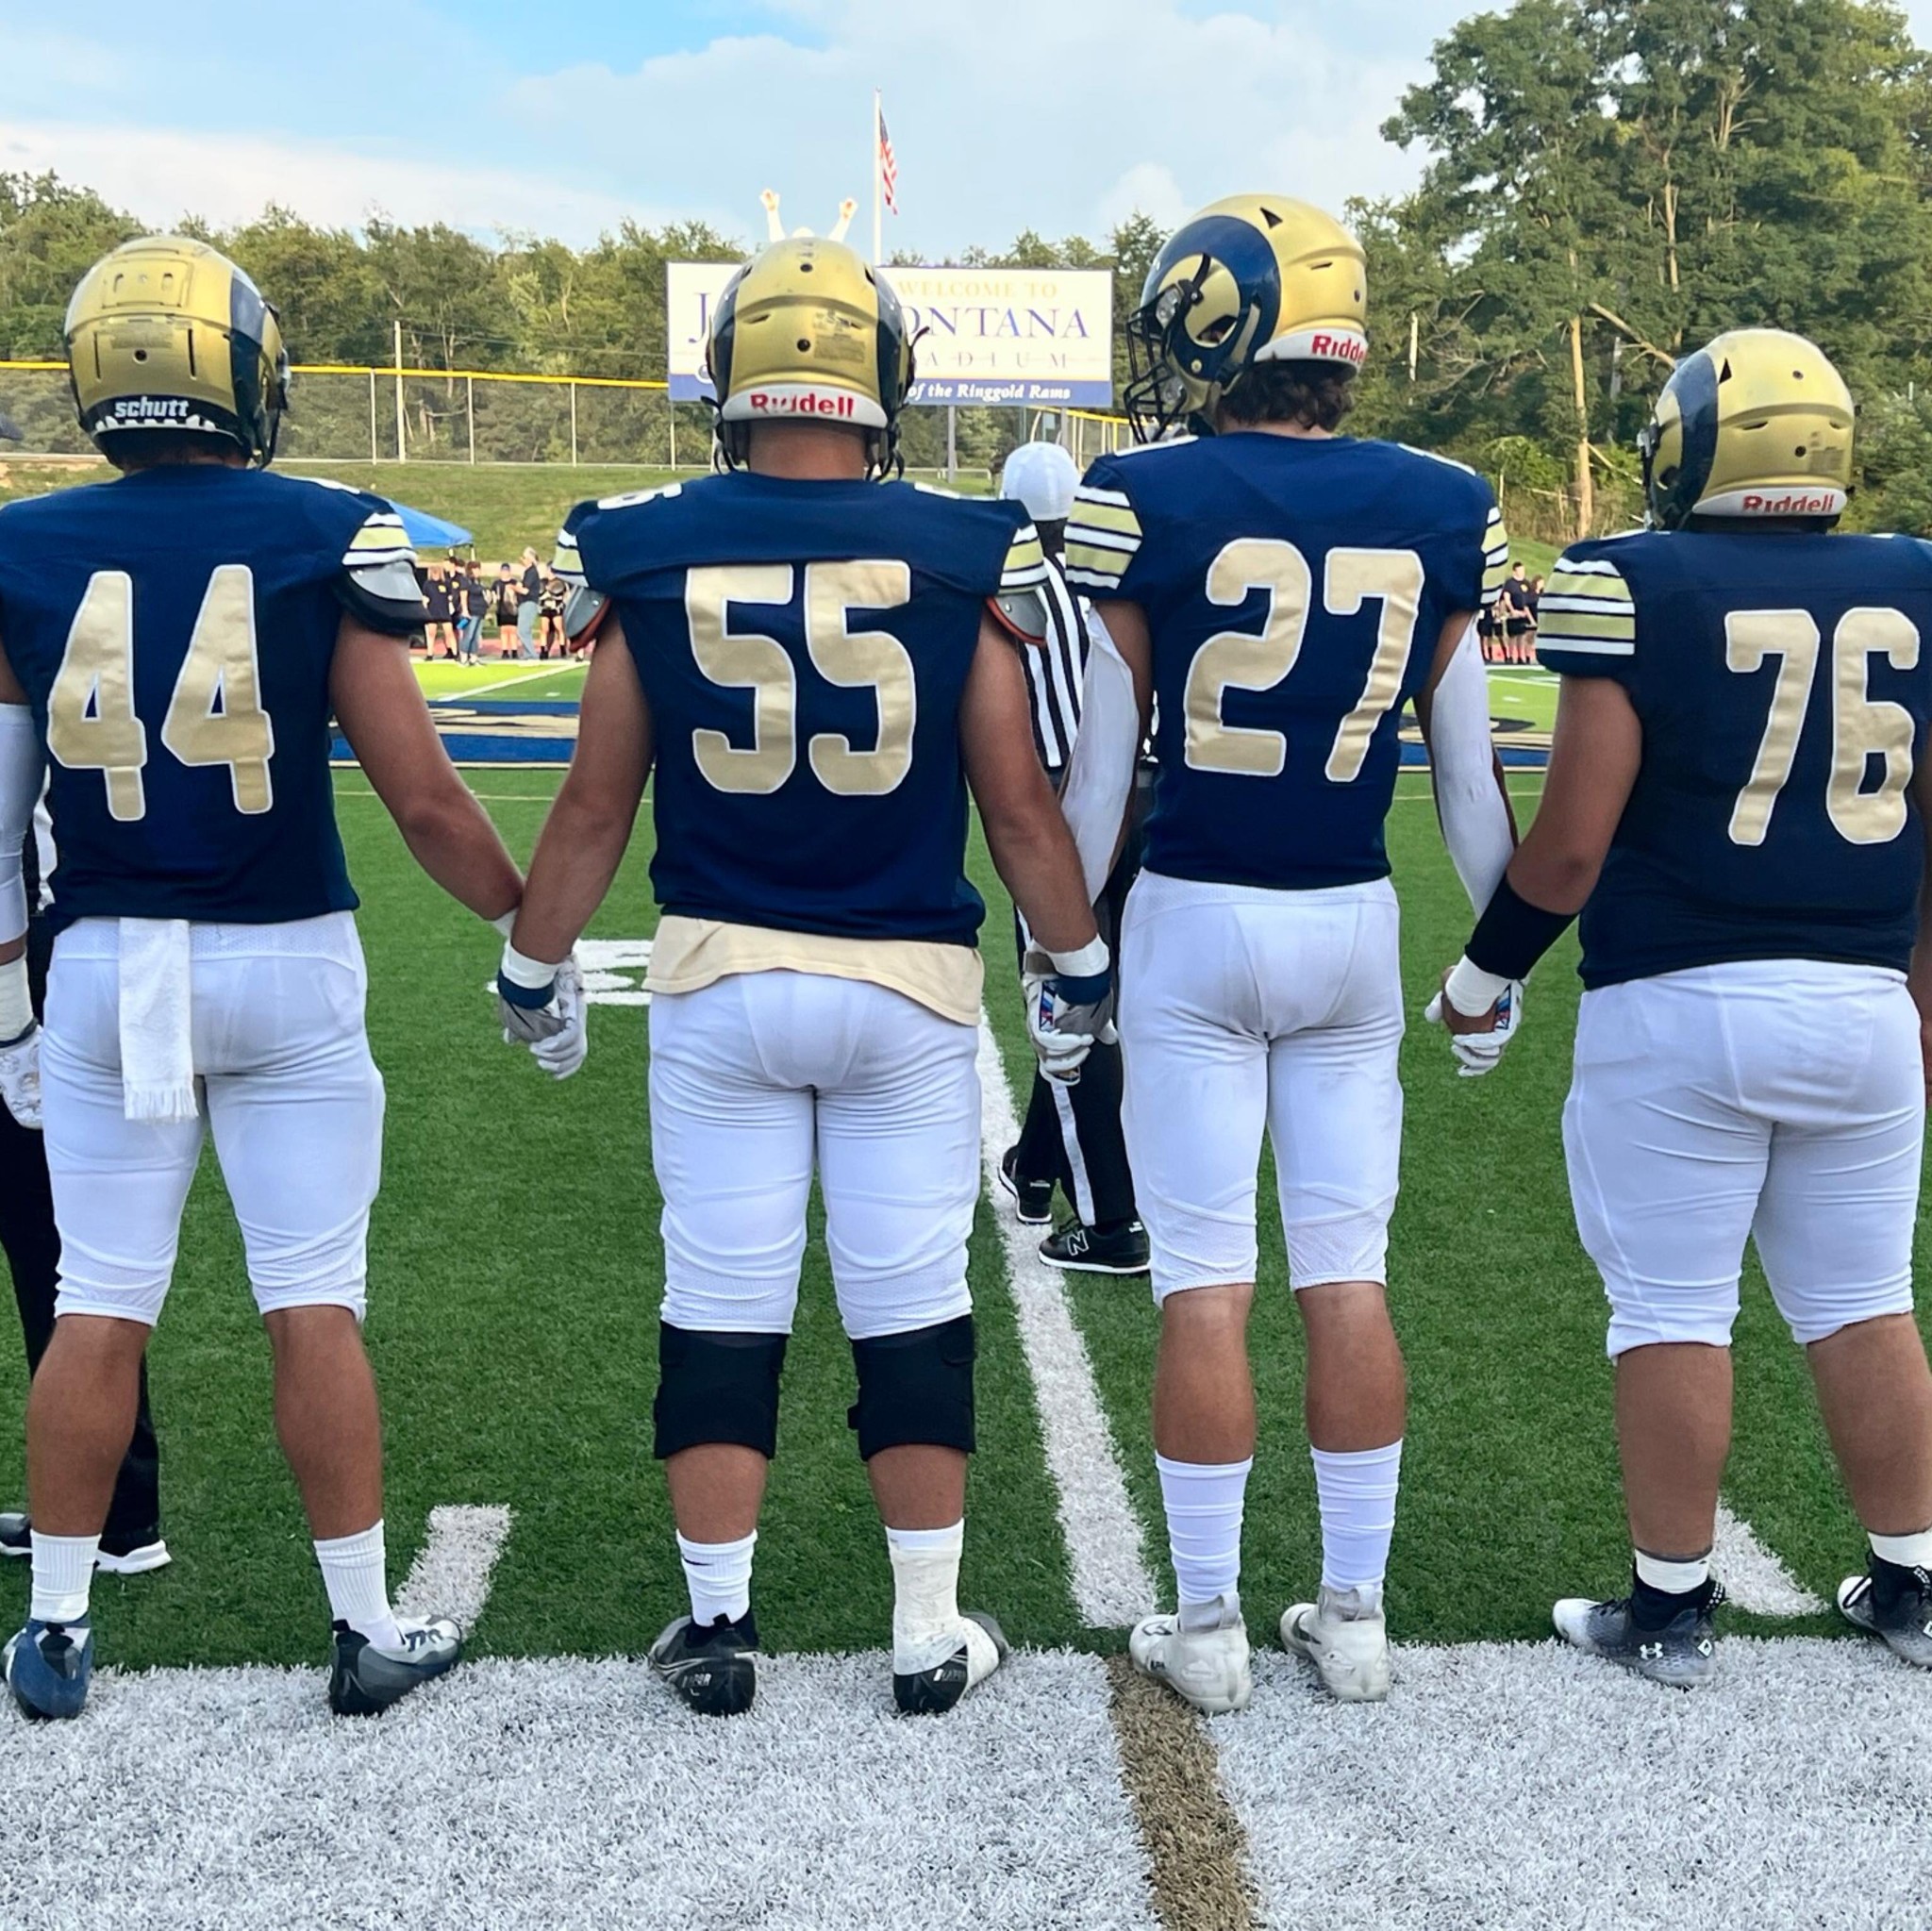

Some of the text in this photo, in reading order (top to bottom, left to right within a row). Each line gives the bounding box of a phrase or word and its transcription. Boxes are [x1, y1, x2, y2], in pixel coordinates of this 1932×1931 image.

[898, 280, 1058, 299] WELCOME TO
[908, 382, 1071, 402] of the Ringgold Rams
[114, 395, 190, 418] schutt
[1741, 493, 1835, 513] Riddell
[1183, 538, 1425, 783] 27
[685, 558, 917, 796] 55
[46, 563, 275, 822] 44
[1724, 607, 1921, 846] 76
[1066, 1229, 1090, 1257] N
